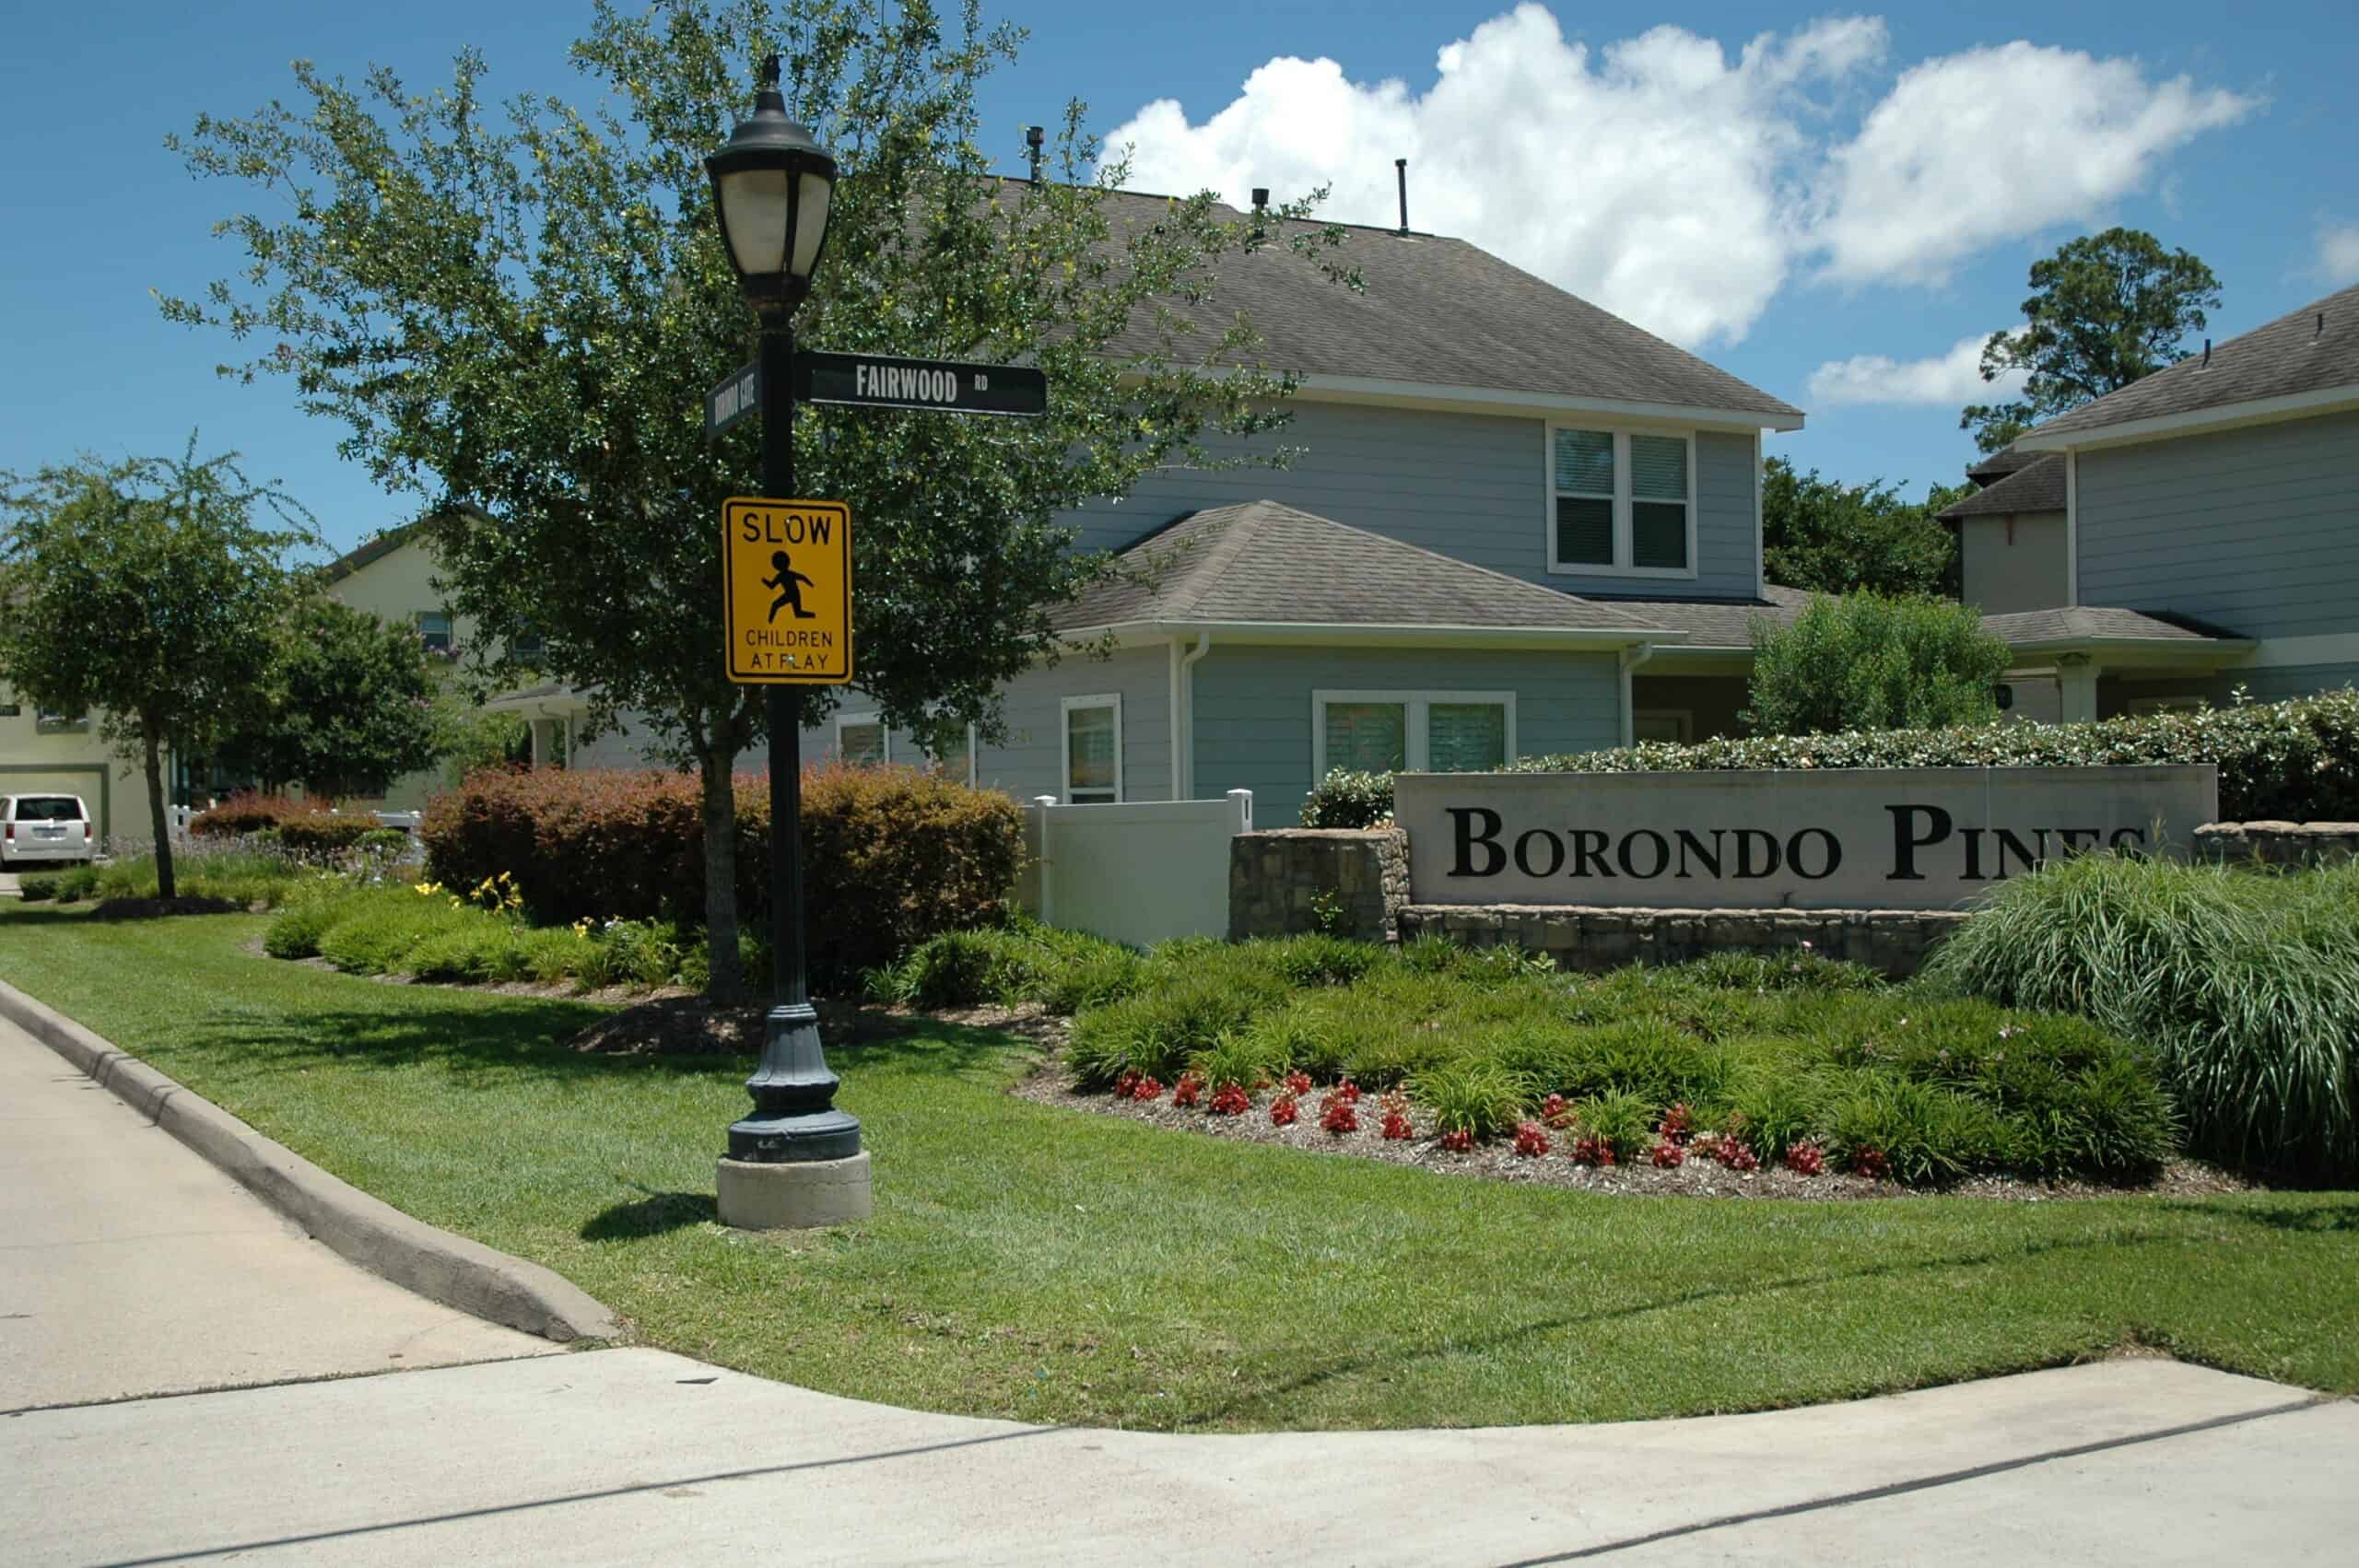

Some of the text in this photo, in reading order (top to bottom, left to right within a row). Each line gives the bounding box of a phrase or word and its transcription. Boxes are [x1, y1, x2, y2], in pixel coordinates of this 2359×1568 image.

[856, 365, 988, 403] FAIRWOOD RD
[742, 512, 831, 545] SLOW
[745, 629, 833, 648] CHILDREN
[751, 652, 828, 670] AT PLAY
[1445, 807, 1842, 880] BORONDO
